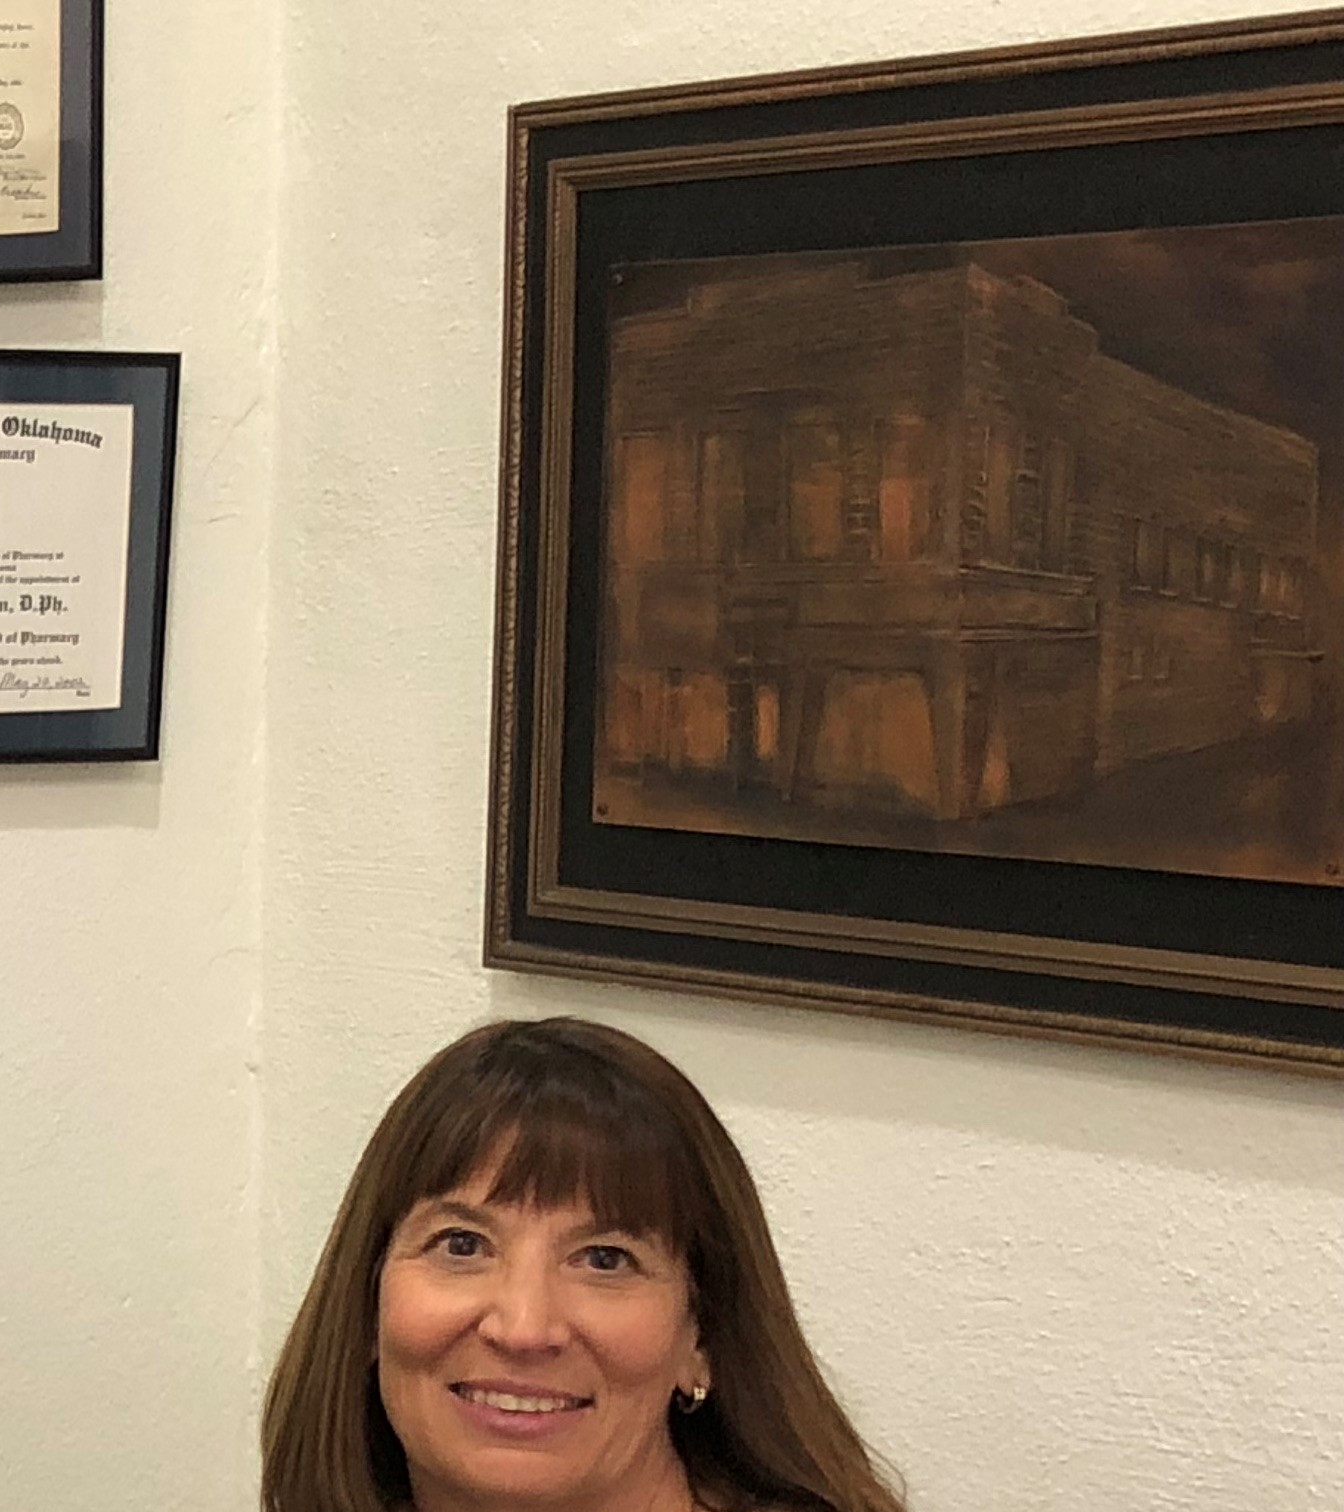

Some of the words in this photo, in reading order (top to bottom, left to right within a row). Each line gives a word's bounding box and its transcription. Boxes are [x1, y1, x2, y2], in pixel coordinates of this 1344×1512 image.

[2, 416, 103, 449] Oklahoma
[20, 594, 69, 615] D.Ph.
[6, 632, 18, 643] of
[20, 630, 80, 645] Pharmacy
